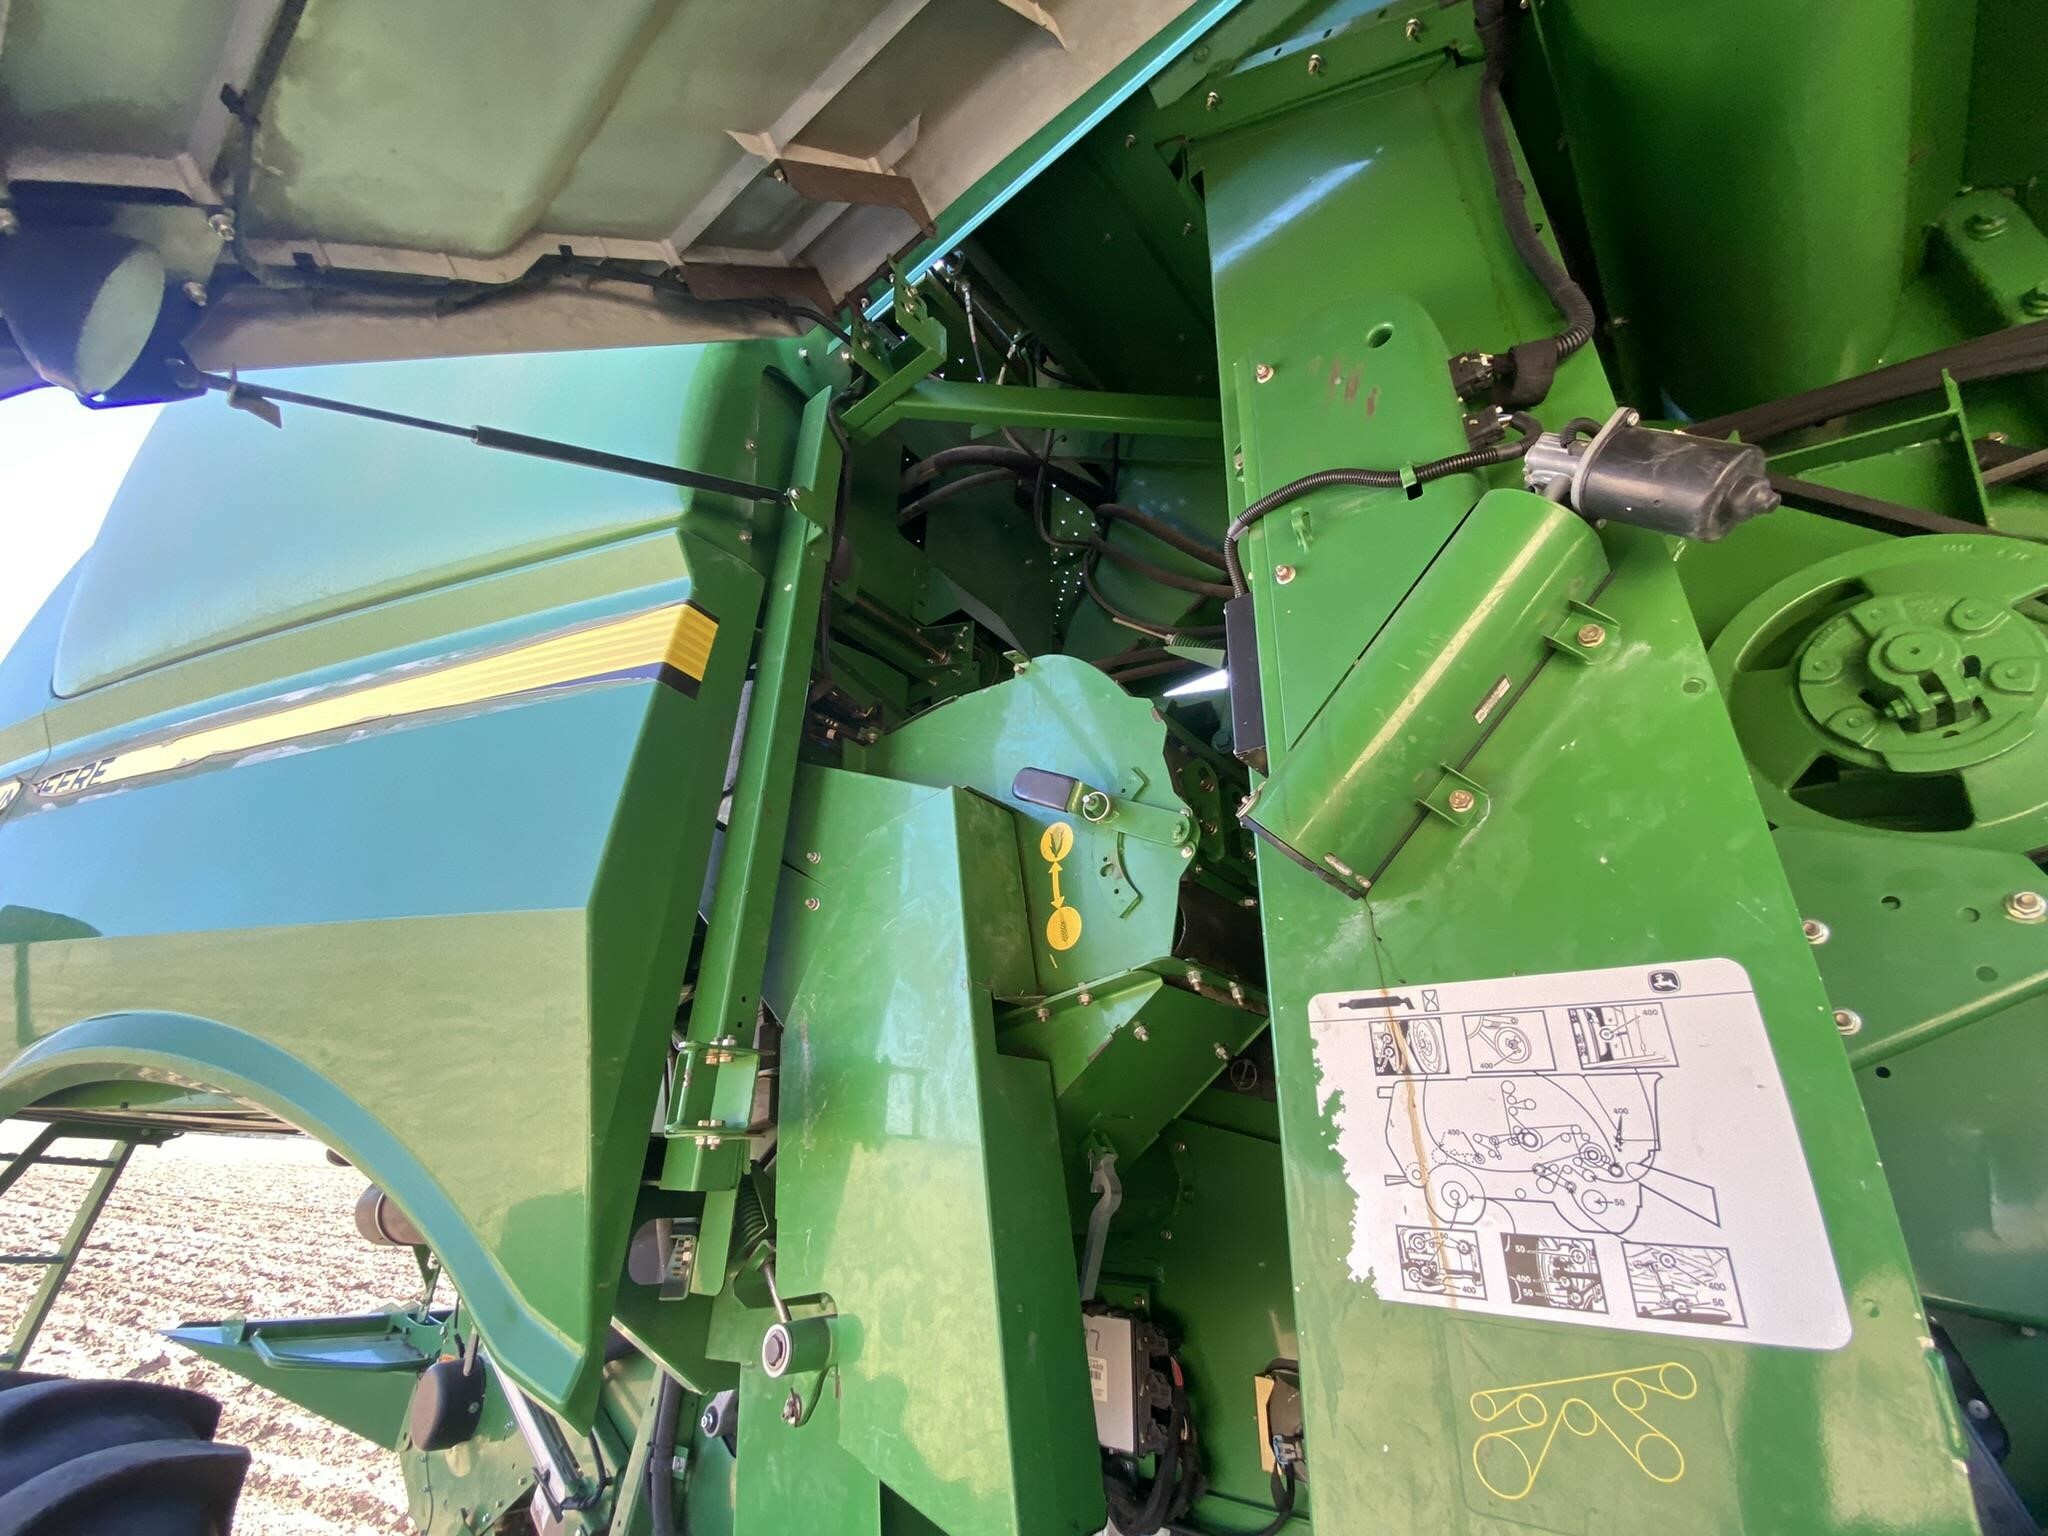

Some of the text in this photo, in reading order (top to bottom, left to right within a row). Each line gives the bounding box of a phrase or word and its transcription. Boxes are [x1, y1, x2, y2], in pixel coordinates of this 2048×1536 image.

[1642, 1008, 1658, 1016] 400
[1613, 1107, 1629, 1115] 400
[1614, 1198, 1626, 1206] 50
[1515, 1245, 1526, 1253] 50
[1516, 1274, 1532, 1283] 400
[1462, 1286, 1477, 1294] 400
[1708, 1282, 1727, 1291] 400
[1522, 1288, 1534, 1297] 50
[1712, 1298, 1725, 1307] 50
